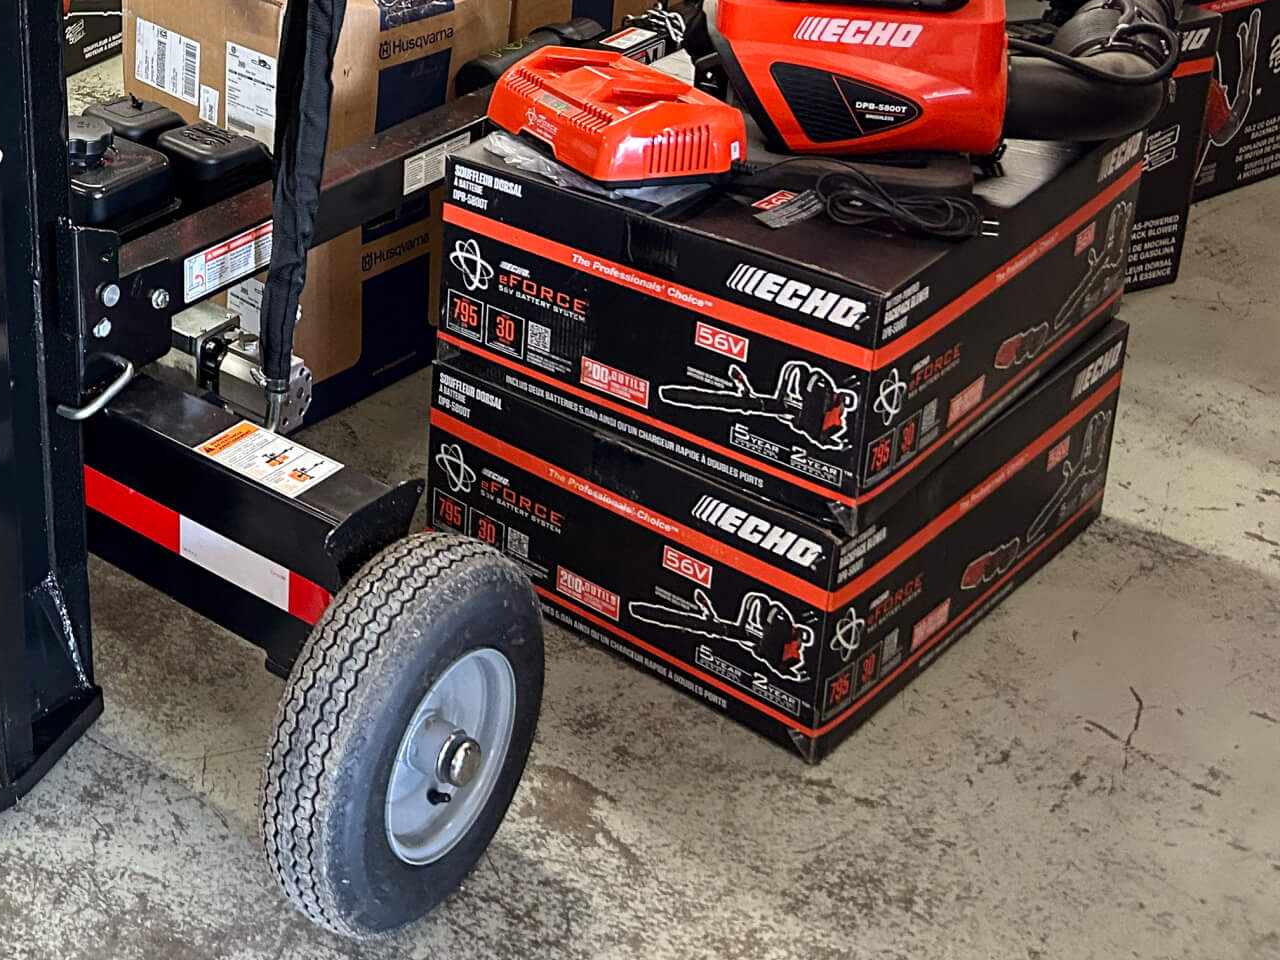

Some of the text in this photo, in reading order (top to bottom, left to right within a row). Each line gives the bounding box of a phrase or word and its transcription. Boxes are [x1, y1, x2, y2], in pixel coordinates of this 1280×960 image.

[392, 27, 454, 55] Husqvarna
[820, 17, 923, 49] ECHO
[855, 101, 908, 113] DPB-5800T
[454, 164, 523, 198] SOUFFLEUR DORSAL
[459, 179, 484, 195] BATTERIE
[1148, 224, 1178, 237] BLOWER
[374, 233, 430, 263] Husqvarna
[572, 253, 590, 268] The
[592, 259, 665, 294] Professionals'
[498, 273, 590, 315] eFORCE
[515, 291, 551, 309] BATTERY
[552, 304, 586, 322] SYSTEM
[754, 273, 867, 331] ECHO
[453, 297, 478, 328] 795
[495, 315, 515, 342] 30
[697, 325, 745, 355] 56V
[439, 372, 502, 411] SOUFFLEUR DORSAL
[611, 372, 647, 392] OUTILS
[505, 374, 528, 391] INCLUS
[528, 382, 545, 399] DEUX
[545, 388, 578, 412] BATTERIES
[599, 410, 616, 428] AINSI
[639, 427, 675, 451] CHARGEUR
[675, 441, 701, 463] RAPIDE
[706, 454, 739, 478] DOUBLES
[739, 468, 765, 488] PORTS
[734, 422, 838, 475] 5 YEAR 2 YEAR
[481, 479, 566, 528] eFORCE
[548, 468, 566, 482] The
[568, 477, 635, 516] Professionals'
[439, 496, 462, 527] 795
[496, 497, 562, 534] BATTERY SYSTEM
[478, 518, 496, 545] 30
[720, 506, 822, 570] ECHO
[664, 548, 710, 582] 56V
[674, 671, 704, 696] DOUBLES
[703, 685, 728, 708] PORTS
[698, 645, 797, 705] 5 YEAR 2 YEAR
